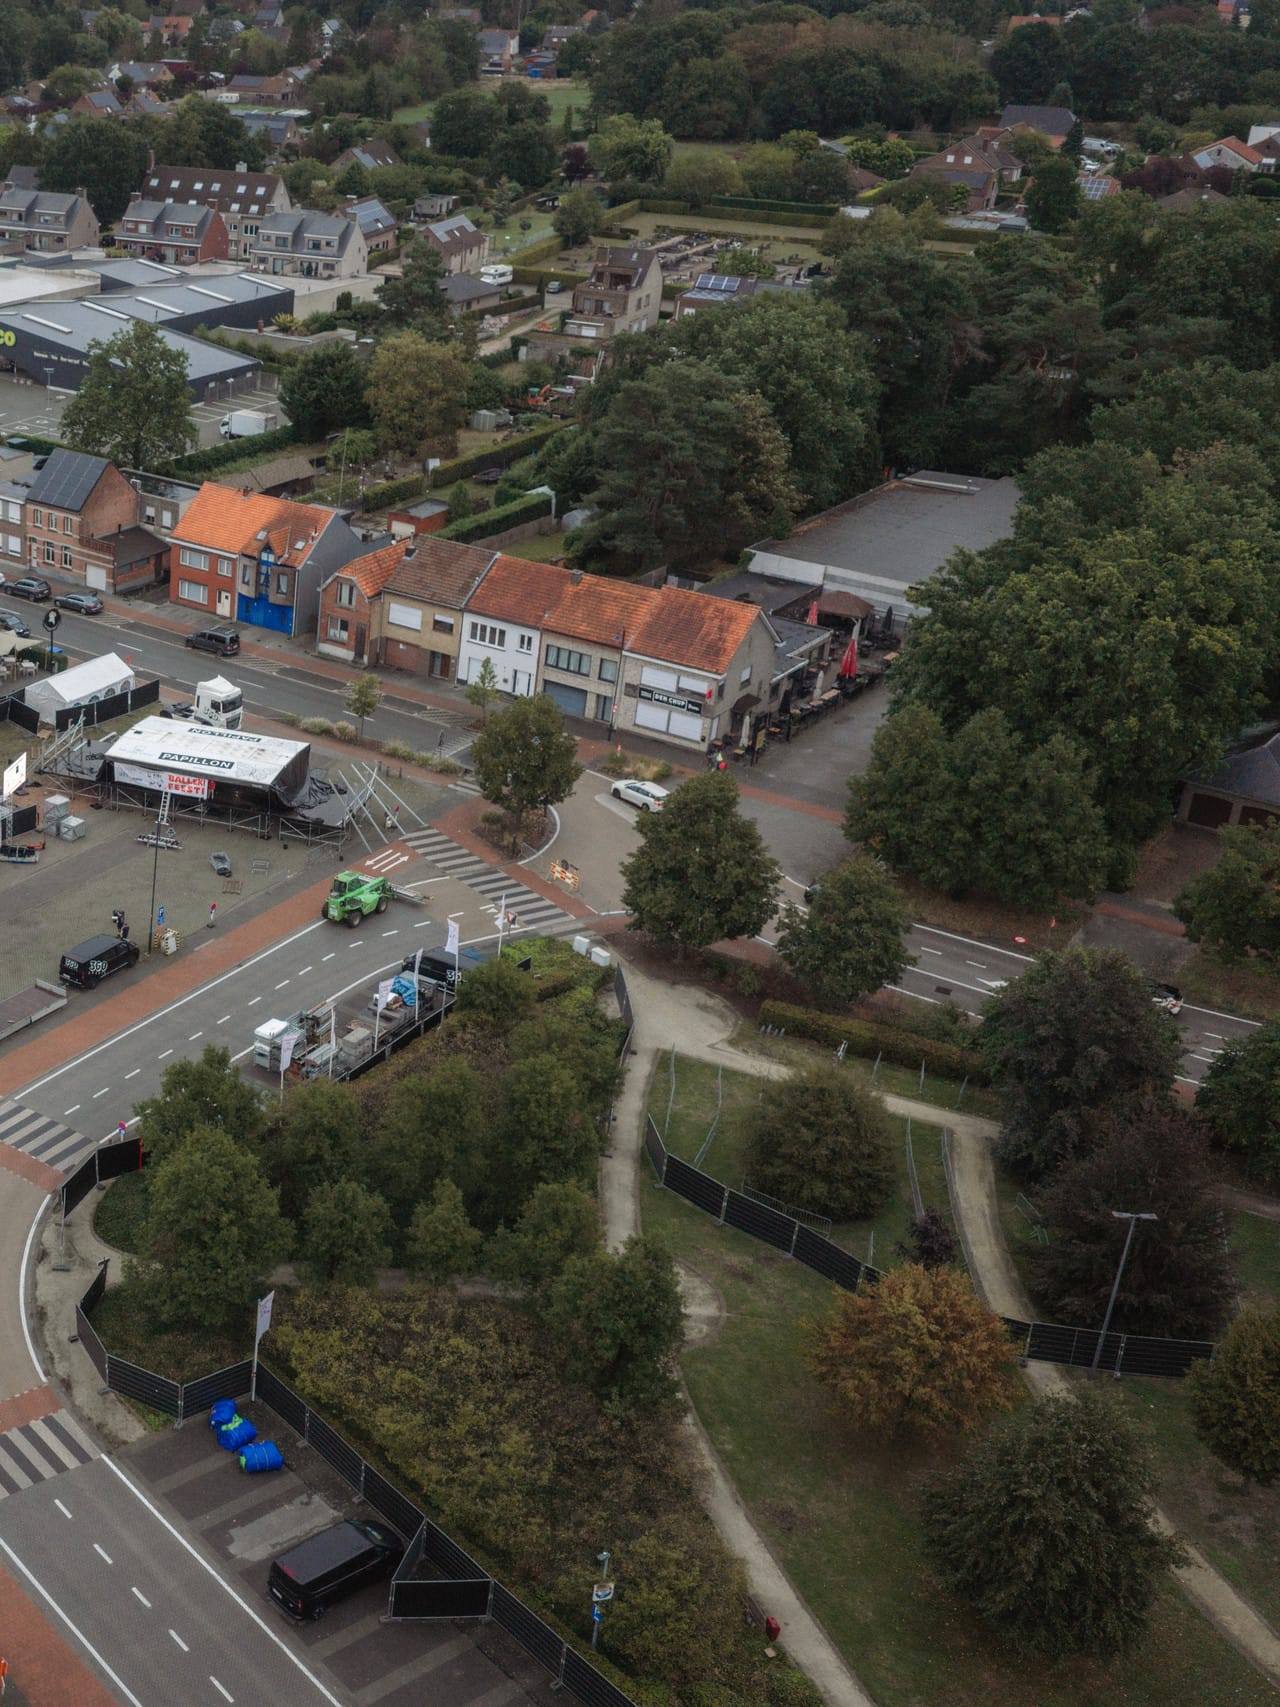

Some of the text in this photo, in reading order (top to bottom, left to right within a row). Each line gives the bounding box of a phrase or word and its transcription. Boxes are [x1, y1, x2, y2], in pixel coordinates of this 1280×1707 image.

[190, 728, 261, 743] PAPILLON
[161, 752, 233, 769] PAPILLON
[89, 960, 109, 972] 360
